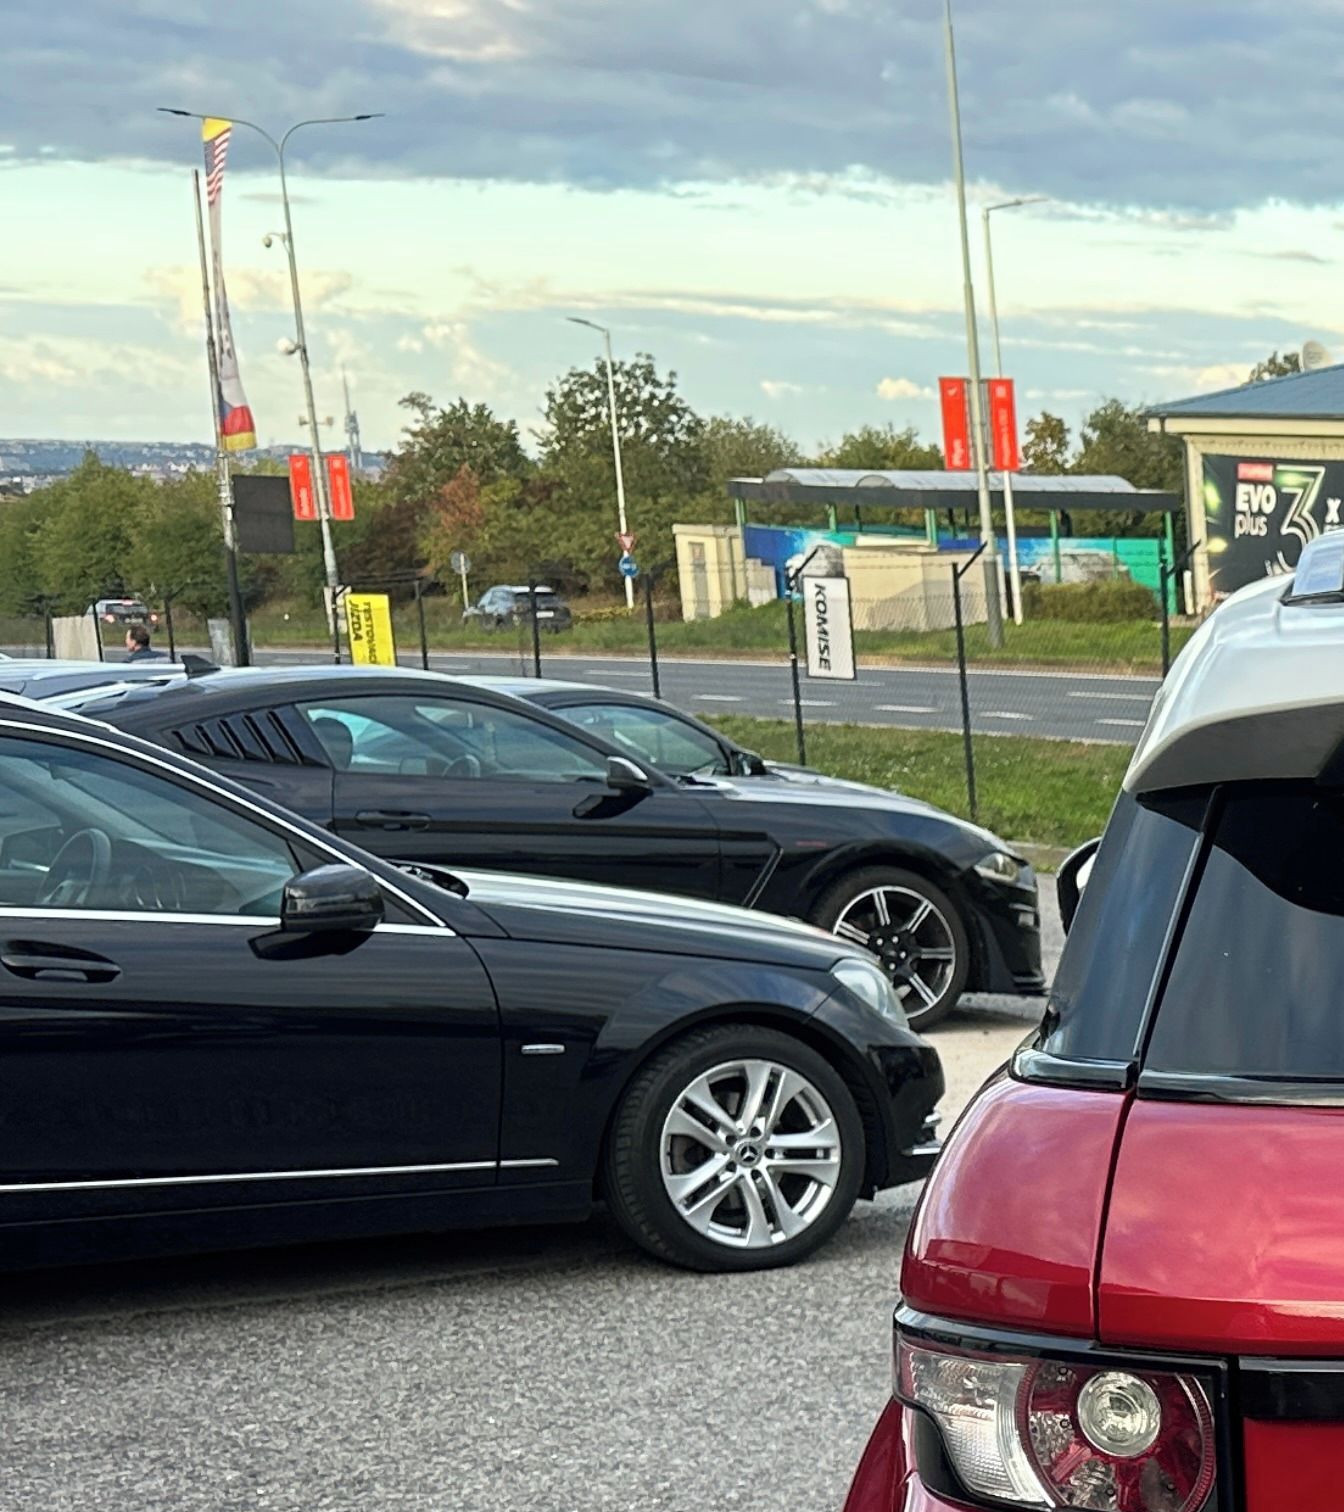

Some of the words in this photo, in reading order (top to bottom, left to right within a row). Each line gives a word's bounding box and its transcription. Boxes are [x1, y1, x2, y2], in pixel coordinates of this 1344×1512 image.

[1235, 483, 1276, 514] EVO
[1234, 510, 1268, 538] plus
[815, 583, 831, 671] KOMISE
